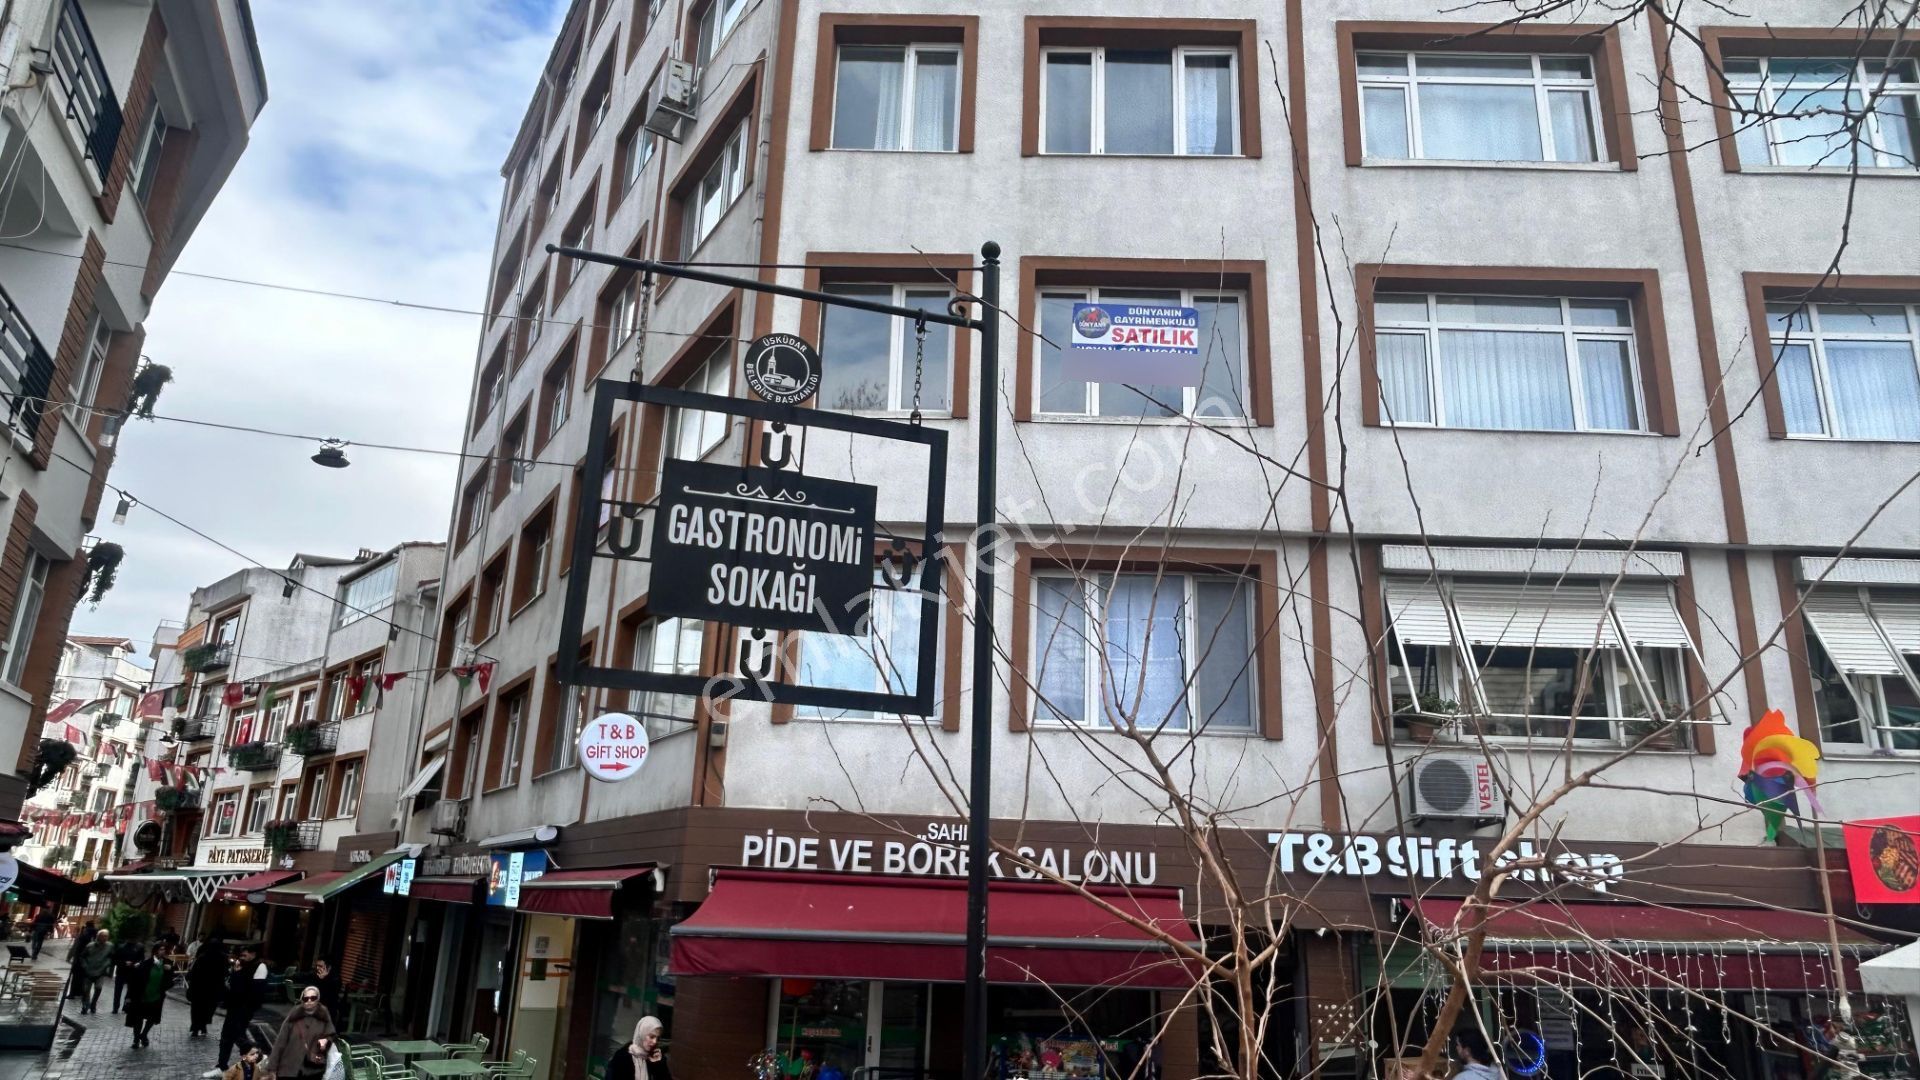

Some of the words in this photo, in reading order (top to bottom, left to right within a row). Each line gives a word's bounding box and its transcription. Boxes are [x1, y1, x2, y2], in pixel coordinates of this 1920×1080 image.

[1128, 307, 1182, 317] DÜNYANIN
[1114, 316, 1196, 327] GAYRİMENKULÜ
[763, 335, 808, 353] ÜSKÜDAR
[1111, 327, 1194, 346] SATILIK
[707, 561, 816, 614] SOKAĞI
[599, 724, 607, 739] T
[610, 724, 622, 739] &
[626, 725, 635, 739] B
[615, 746, 647, 758] SHOP
[1477, 761, 1492, 811] VESTEL
[742, 828, 819, 870] PİDE
[829, 838, 873, 872] VE
[883, 834, 1005, 877] BÖREK
[1015, 846, 1156, 885] SALONU
[1268, 833, 1382, 876] T&B
[1386, 837, 1481, 880] gift
